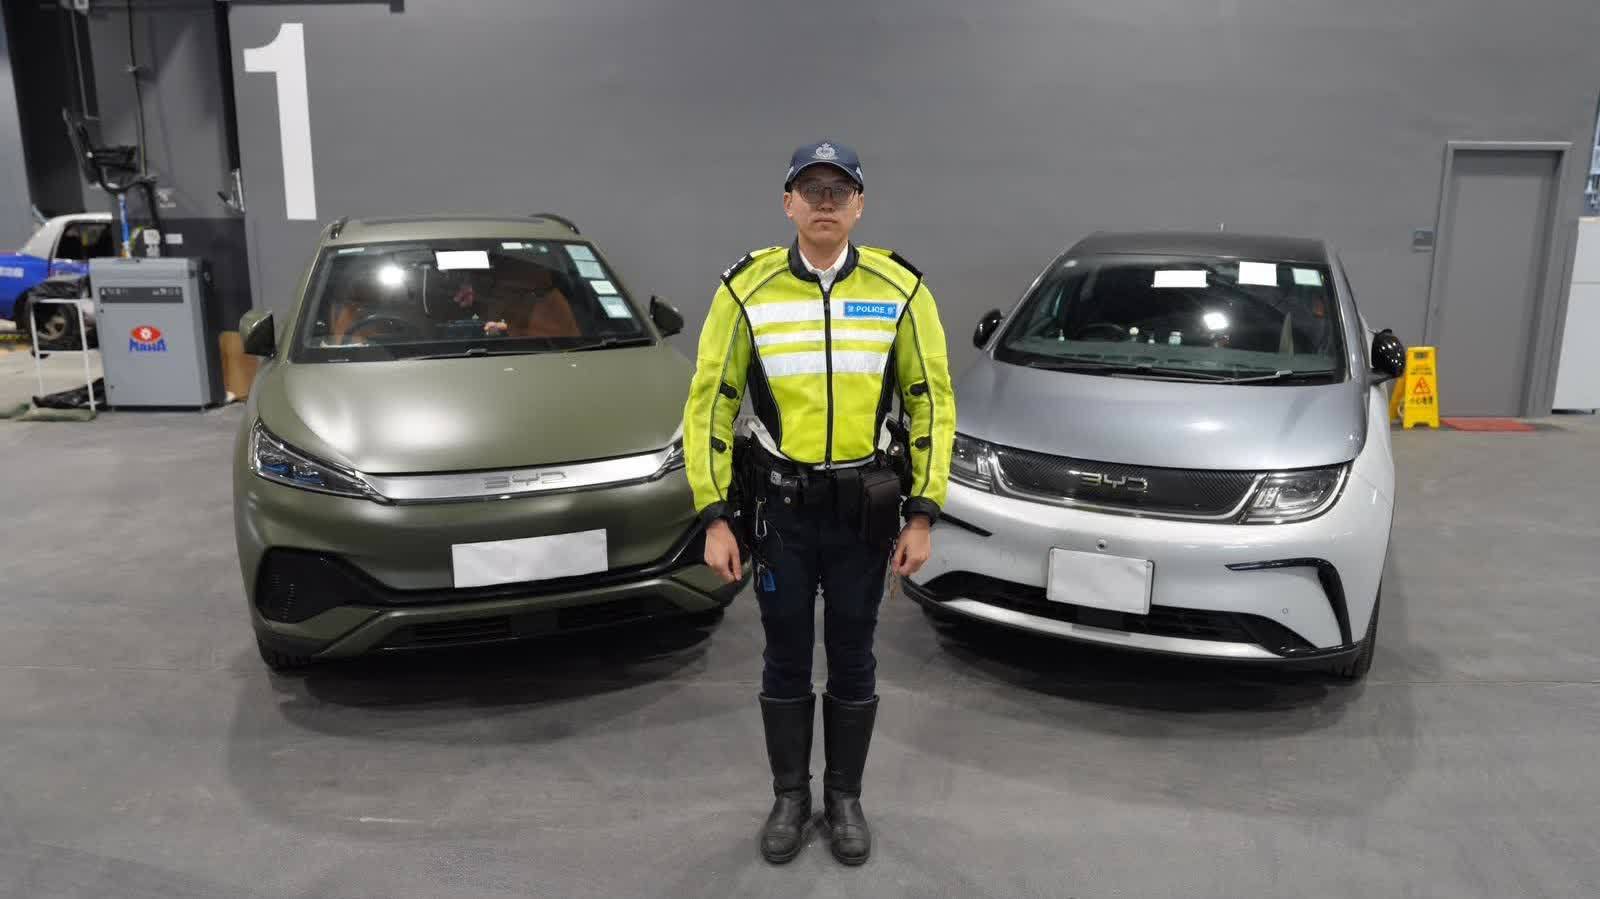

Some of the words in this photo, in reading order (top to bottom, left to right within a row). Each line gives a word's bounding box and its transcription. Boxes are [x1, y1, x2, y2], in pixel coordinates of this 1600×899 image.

[243, 23, 317, 220] 1
[855, 305, 886, 314] POLICE
[484, 471, 567, 489] BYD
[1067, 470, 1148, 491] BYD
